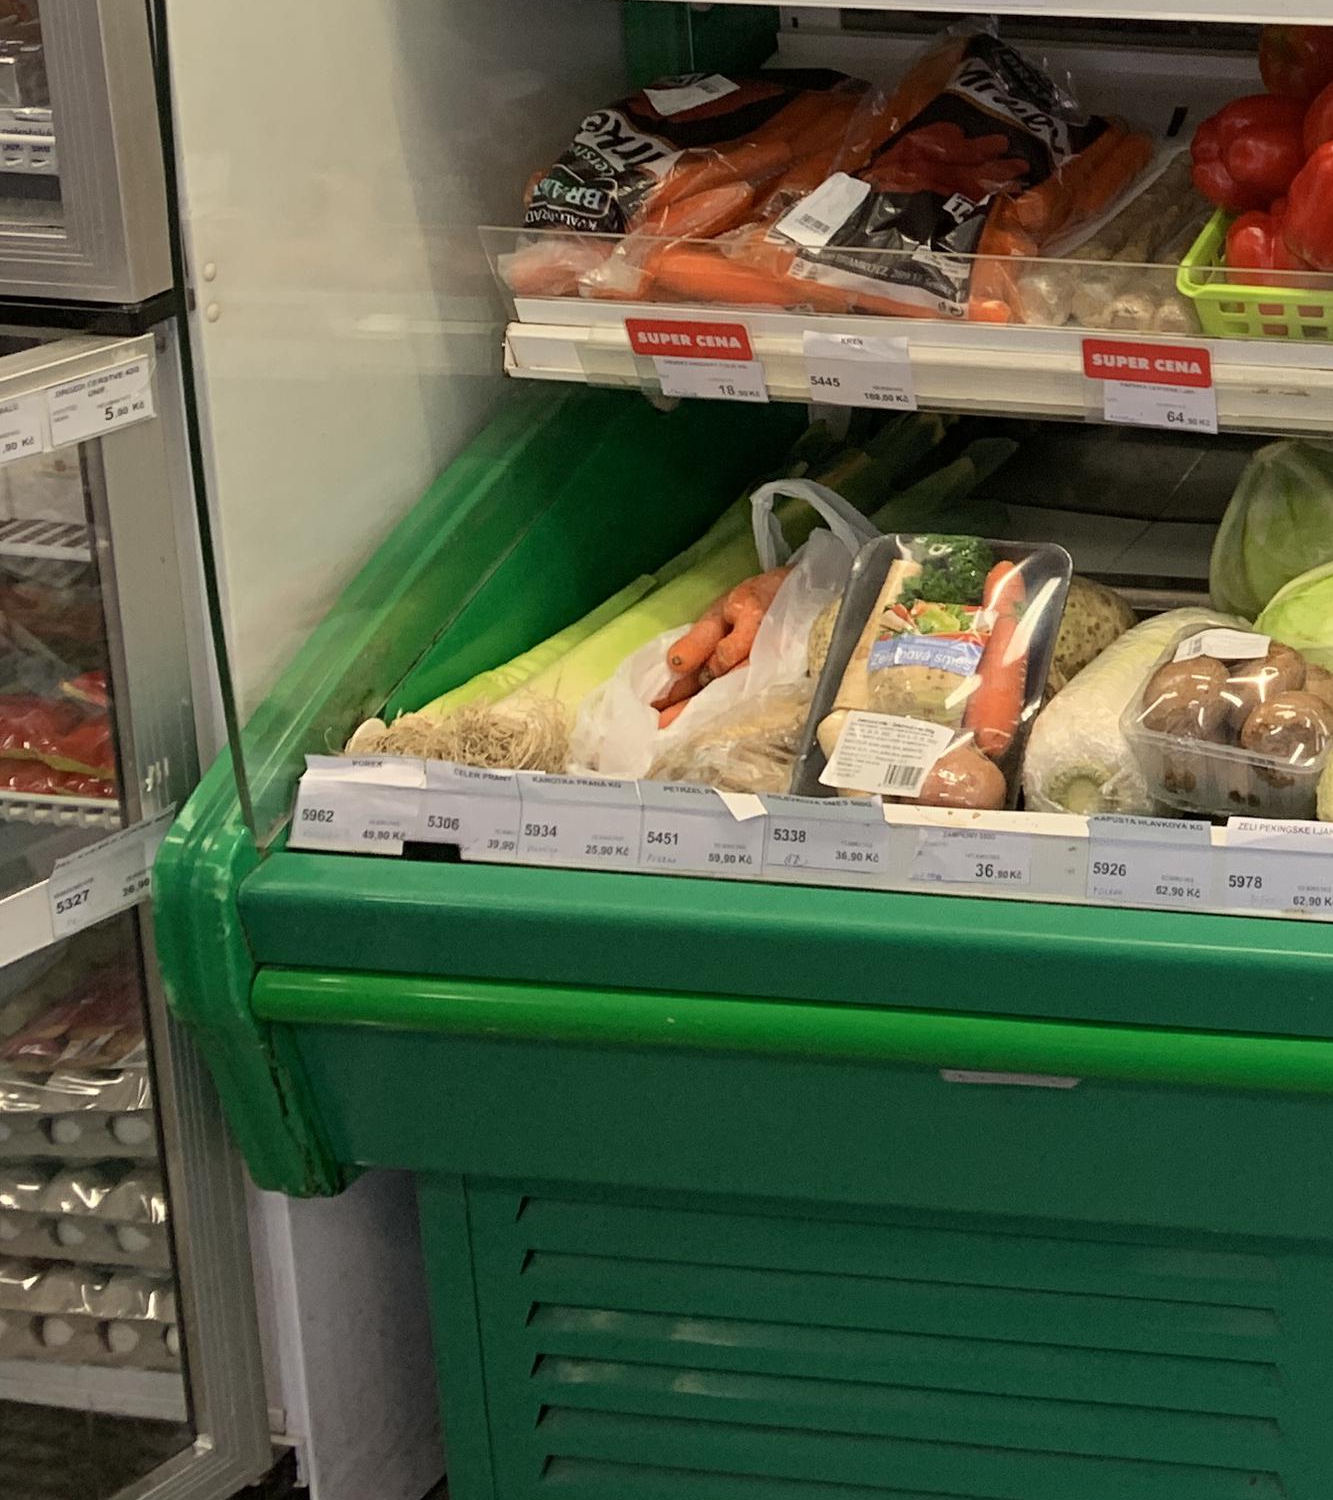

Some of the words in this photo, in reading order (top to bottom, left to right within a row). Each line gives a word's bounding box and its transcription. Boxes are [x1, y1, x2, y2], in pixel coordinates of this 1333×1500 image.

[636, 331, 693, 348] SUPER
[696, 334, 742, 351] CENA
[1091, 353, 1150, 370] SUPER
[1155, 357, 1202, 375] CENA
[810, 375, 841, 389] 5445
[302, 808, 334, 823] 5962
[427, 816, 460, 830] 5306
[524, 823, 557, 838] 5934
[647, 831, 679, 845] 5451
[773, 828, 806, 843] 5338
[1093, 861, 1127, 877] 5926
[1228, 874, 1262, 890] 5978
[56, 890, 90, 914] 5327
